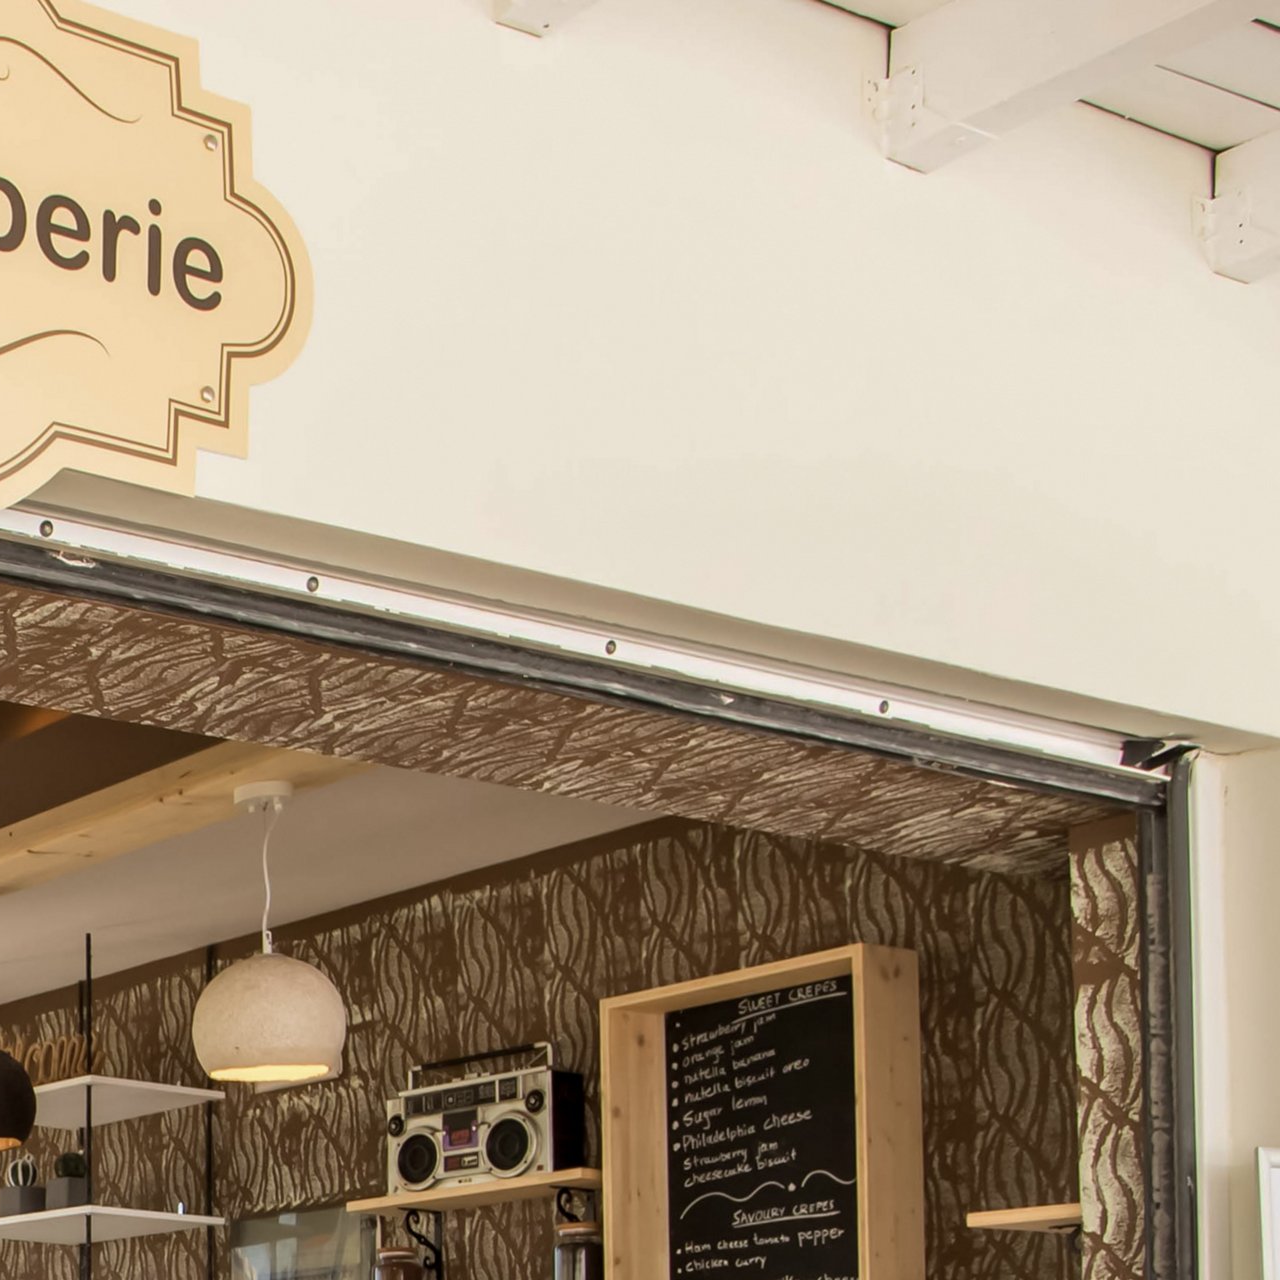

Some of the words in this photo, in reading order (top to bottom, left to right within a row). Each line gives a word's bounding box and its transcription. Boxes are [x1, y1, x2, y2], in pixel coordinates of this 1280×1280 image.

[738, 992, 781, 1015] SWEET
[788, 980, 837, 1001] CREPES
[753, 1013, 776, 1033] jam
[731, 1035, 755, 1056] jam
[683, 1107, 723, 1130] Sugar
[682, 1124, 756, 1152] Philadelphia
[757, 1141, 779, 1157] jam
[731, 1207, 786, 1226] SAVOURY
[792, 1199, 835, 1216] CREPES
[797, 1227, 844, 1248] pepper
[735, 1255, 767, 1270] curry
